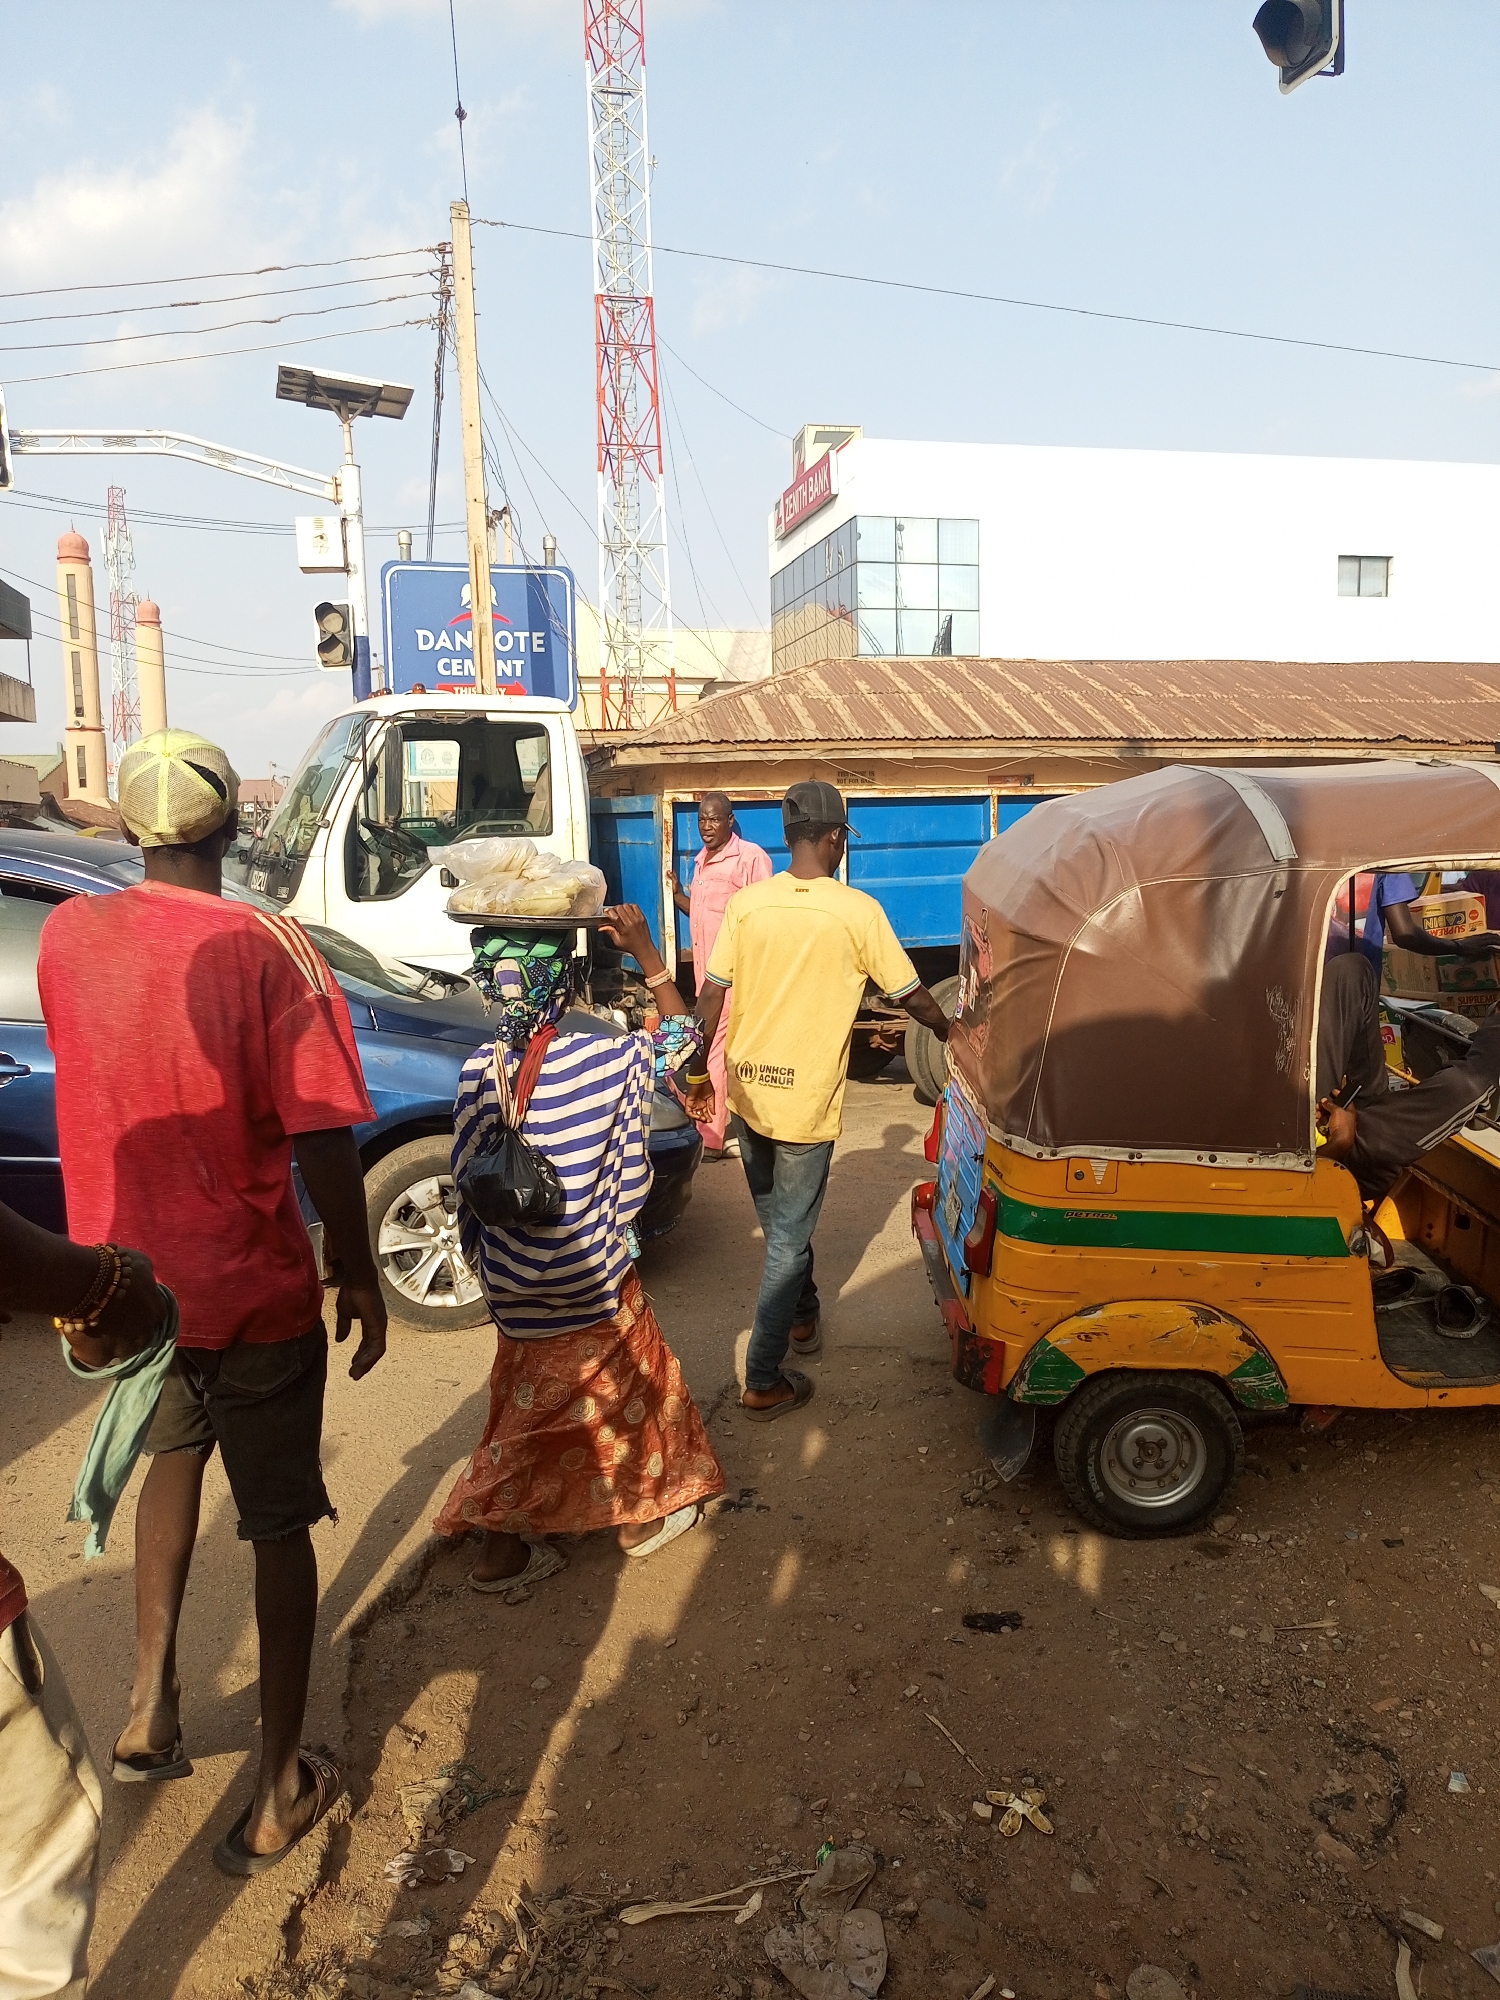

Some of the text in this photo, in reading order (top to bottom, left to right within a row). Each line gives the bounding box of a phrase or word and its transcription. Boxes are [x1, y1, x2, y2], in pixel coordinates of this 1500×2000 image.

[785, 463, 829, 523] ZENITH BANK
[415, 629, 546, 653] DANOTE
[437, 657, 525, 677] CEMNT
[1423, 912, 1466, 930] CABIN
[758, 1073, 795, 1086] ACNUR
[759, 1064, 795, 1077] UNHCR
